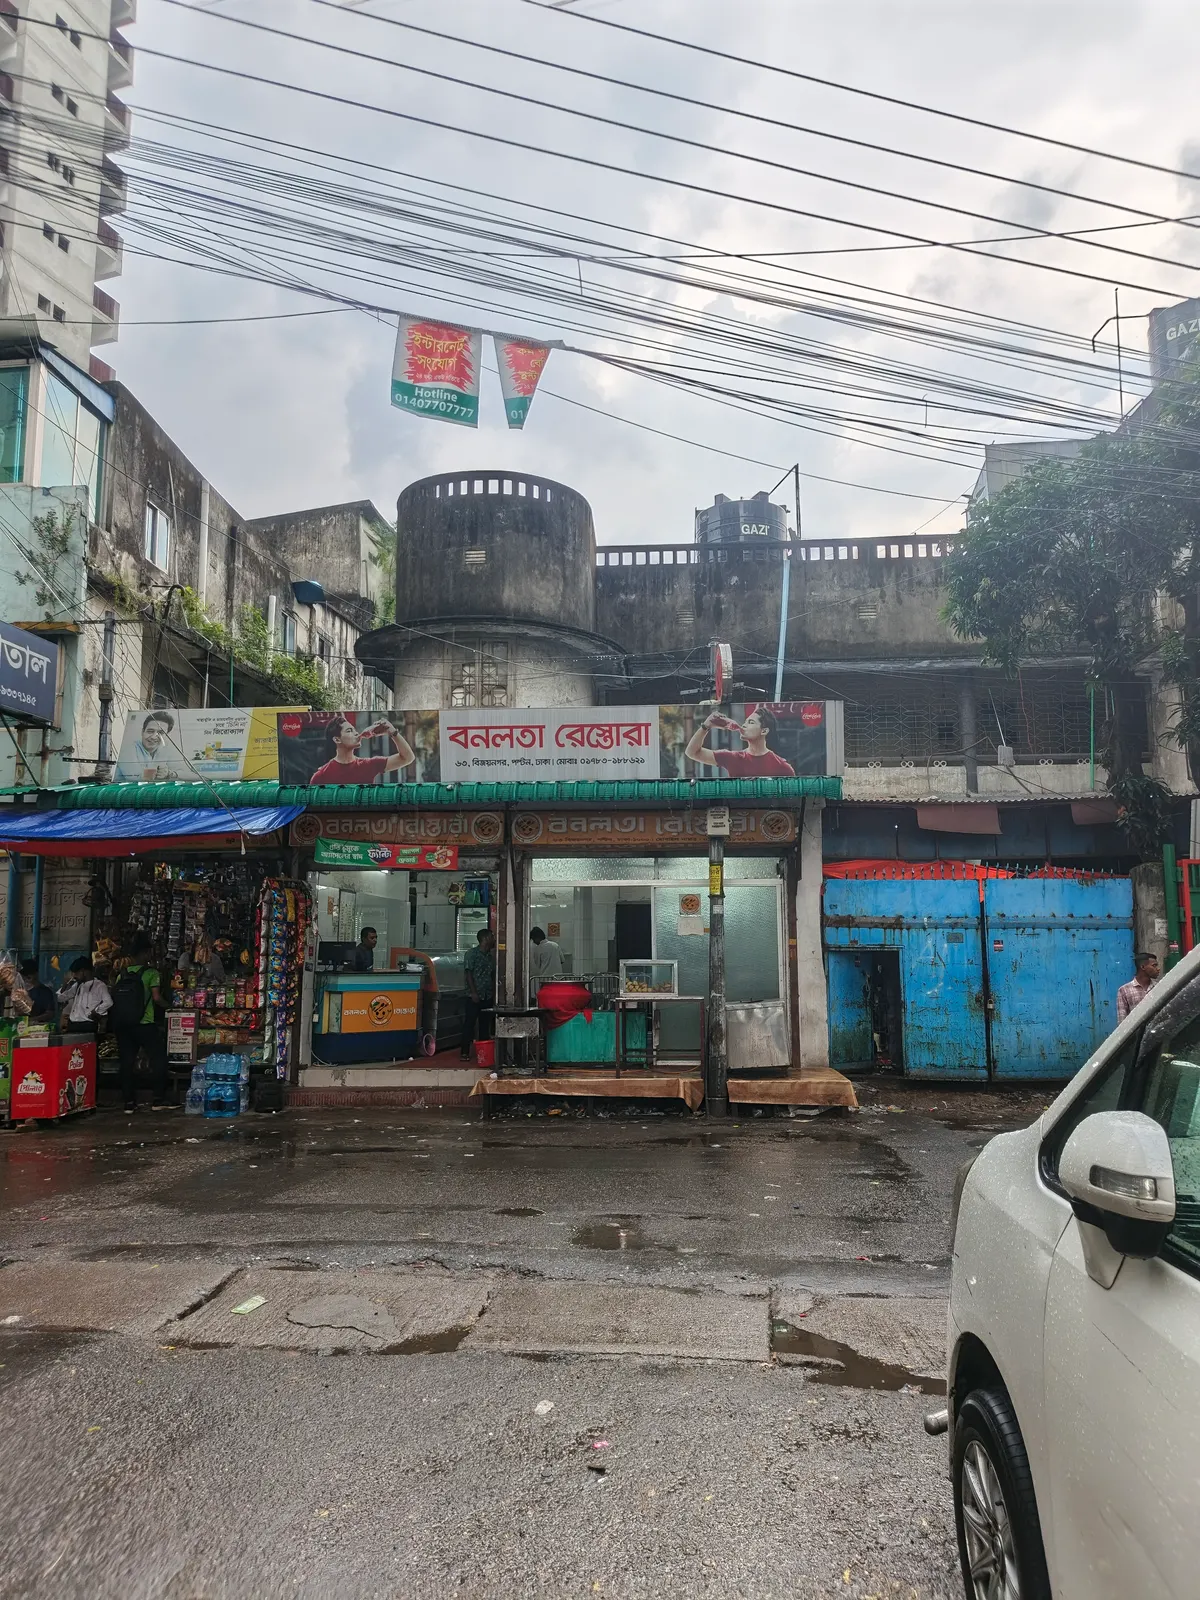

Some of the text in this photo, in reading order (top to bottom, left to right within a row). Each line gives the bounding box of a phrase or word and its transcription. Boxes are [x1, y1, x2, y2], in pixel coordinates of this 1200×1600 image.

[413, 331, 466, 353] ইন্টারনেট
[417, 354, 457, 372] সংযোগ
[414, 386, 458, 402] Hotline
[395, 393, 474, 418] 01407707777
[741, 524, 768, 536] GAZI
[447, 722, 652, 750] বনলতা রেস্তোরা
[580, 756, 646, 765] ০১৭৮৩-১৮৮৬২১
[326, 816, 395, 835] বনলতা
[548, 815, 645, 834] বনলতা
[367, 847, 392, 859] ফ্যান্টা
[69, 1059, 84, 1069] Polar
